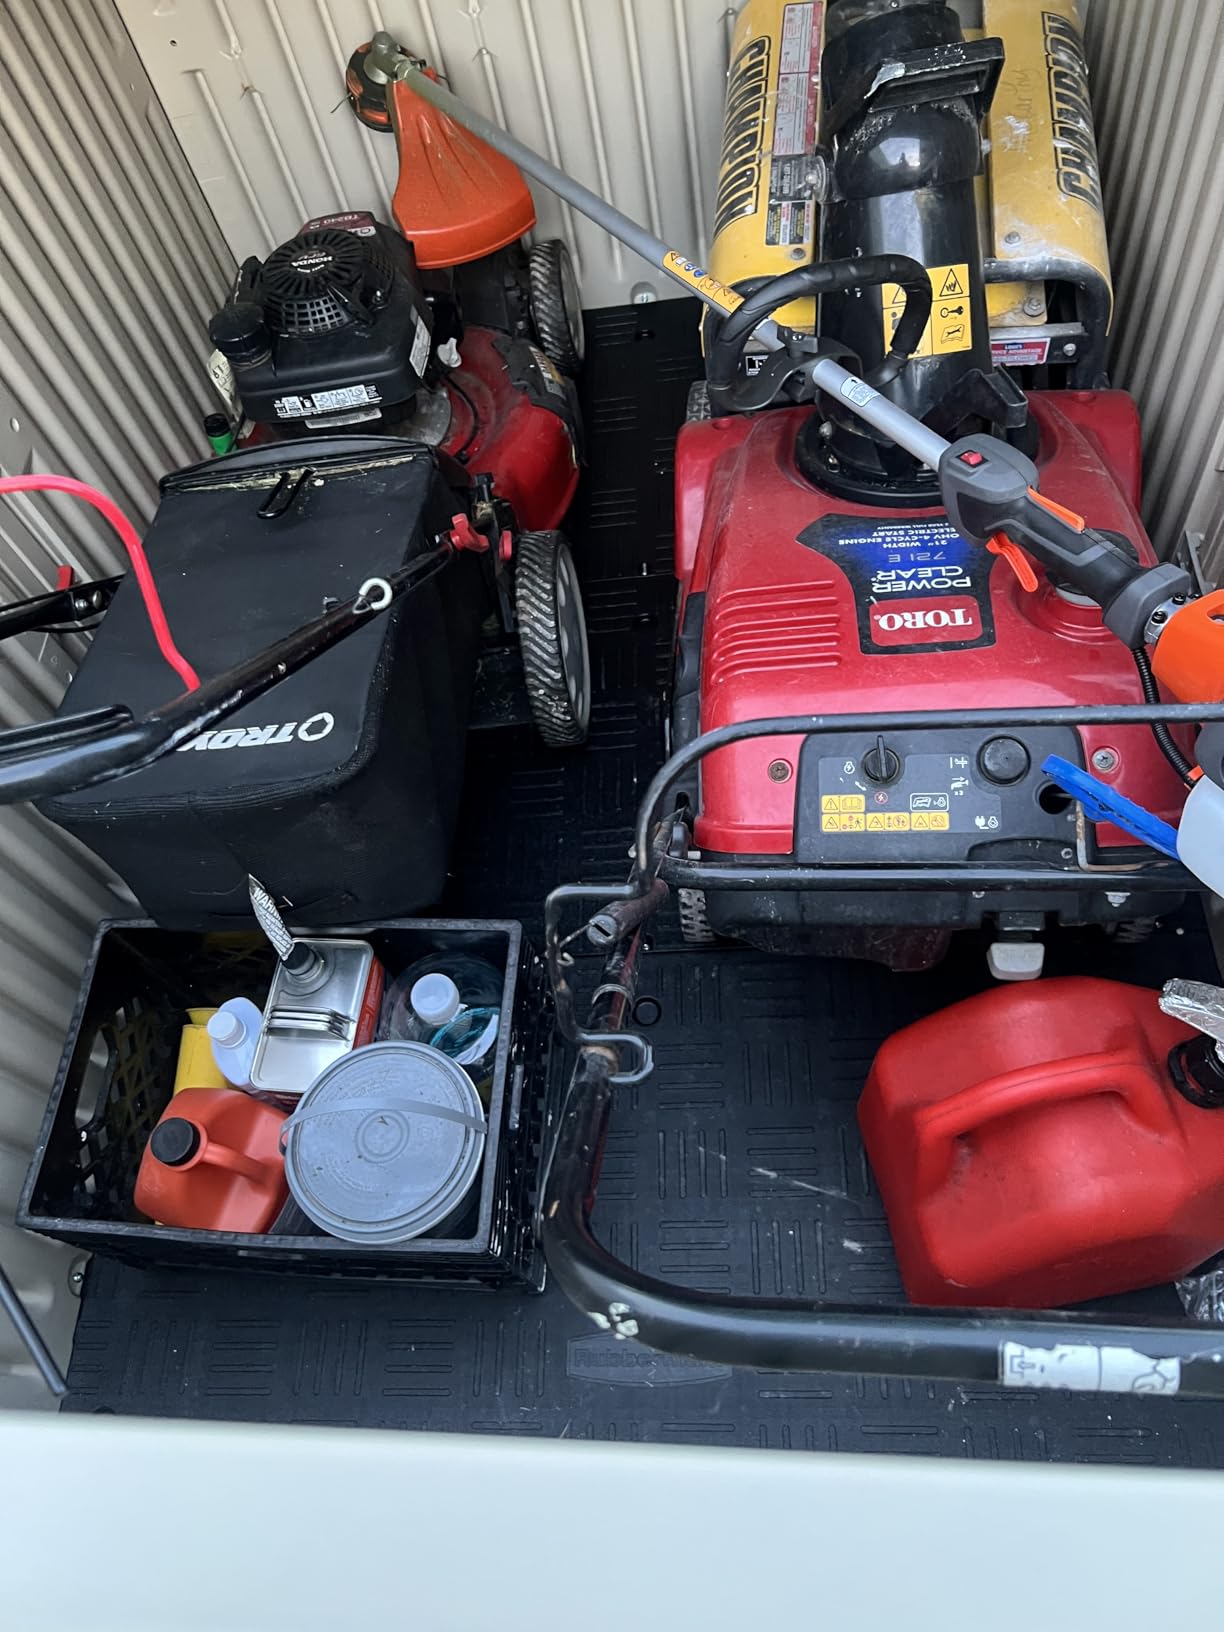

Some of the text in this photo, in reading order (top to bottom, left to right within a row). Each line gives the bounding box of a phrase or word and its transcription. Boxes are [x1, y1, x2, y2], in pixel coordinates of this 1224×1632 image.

[1041, 11, 1101, 209] CHAMPION
[713, 35, 771, 240] CHAMPION
[291, 255, 333, 266] HONDA
[838, 532, 960, 545] OHV 4-CYCLE ENGINE
[871, 527, 956, 537] ELECTRIC START
[887, 551, 946, 563] 721 E
[876, 565, 963, 581] CLEAR
[871, 576, 971, 593] POWER
[879, 608, 973, 631] TORO
